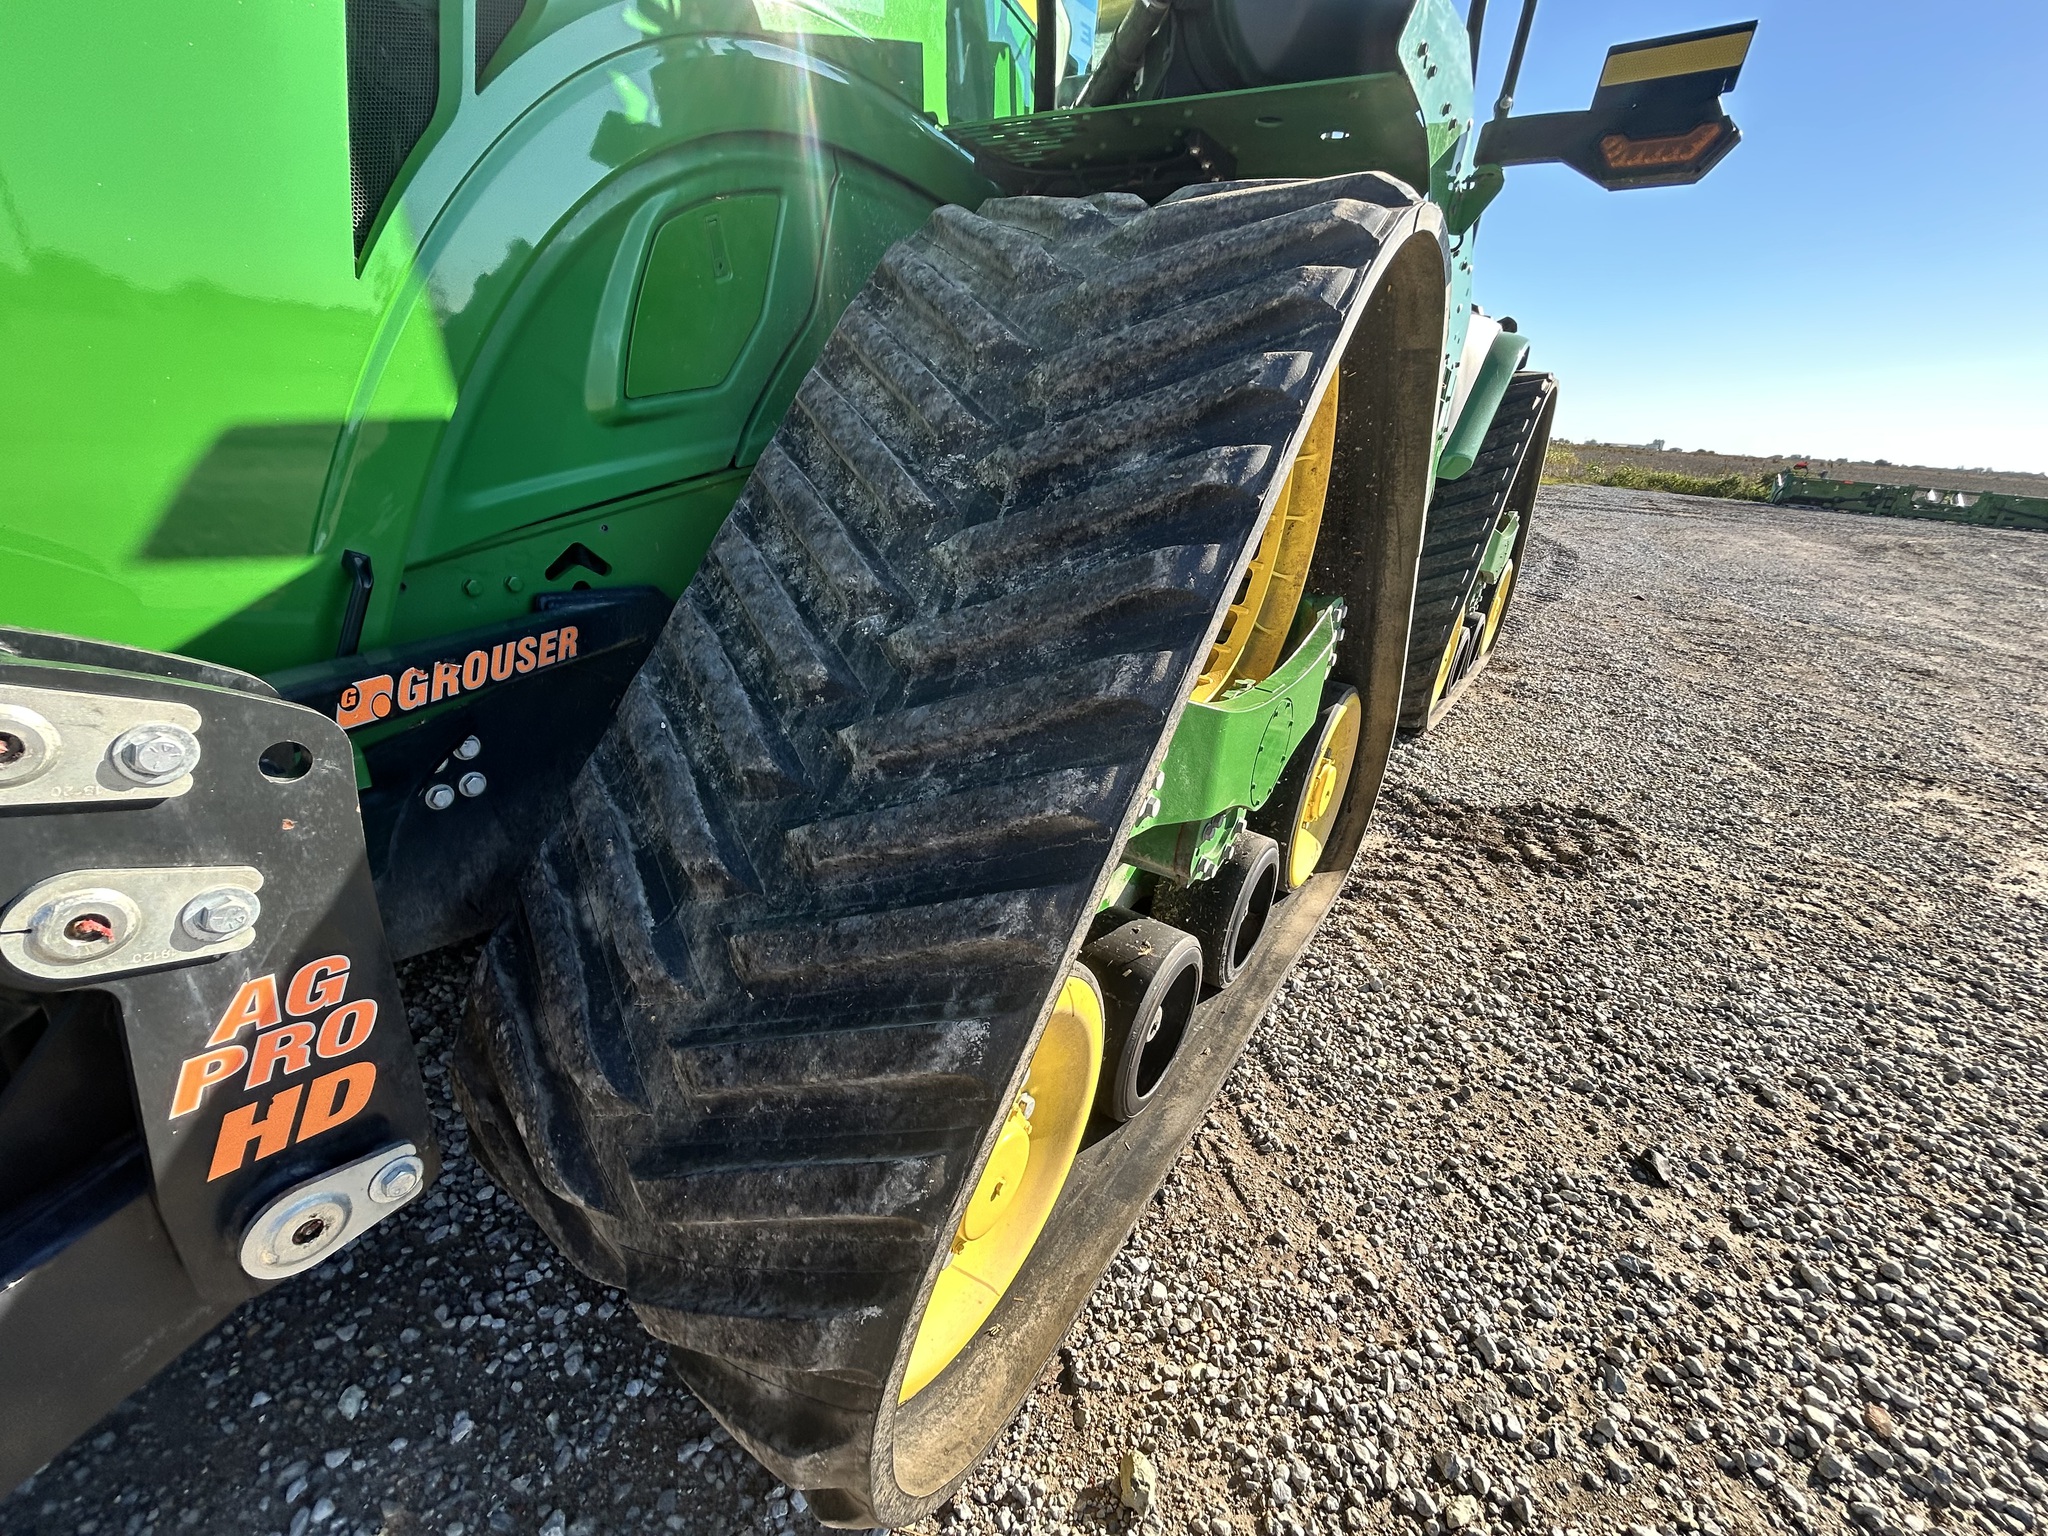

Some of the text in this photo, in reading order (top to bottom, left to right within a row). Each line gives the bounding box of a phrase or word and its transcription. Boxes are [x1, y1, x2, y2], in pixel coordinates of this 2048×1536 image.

[397, 626, 579, 711] GROUSER
[205, 954, 351, 1048] AG
[168, 998, 378, 1121] PRO
[206, 1061, 377, 1182] HD
